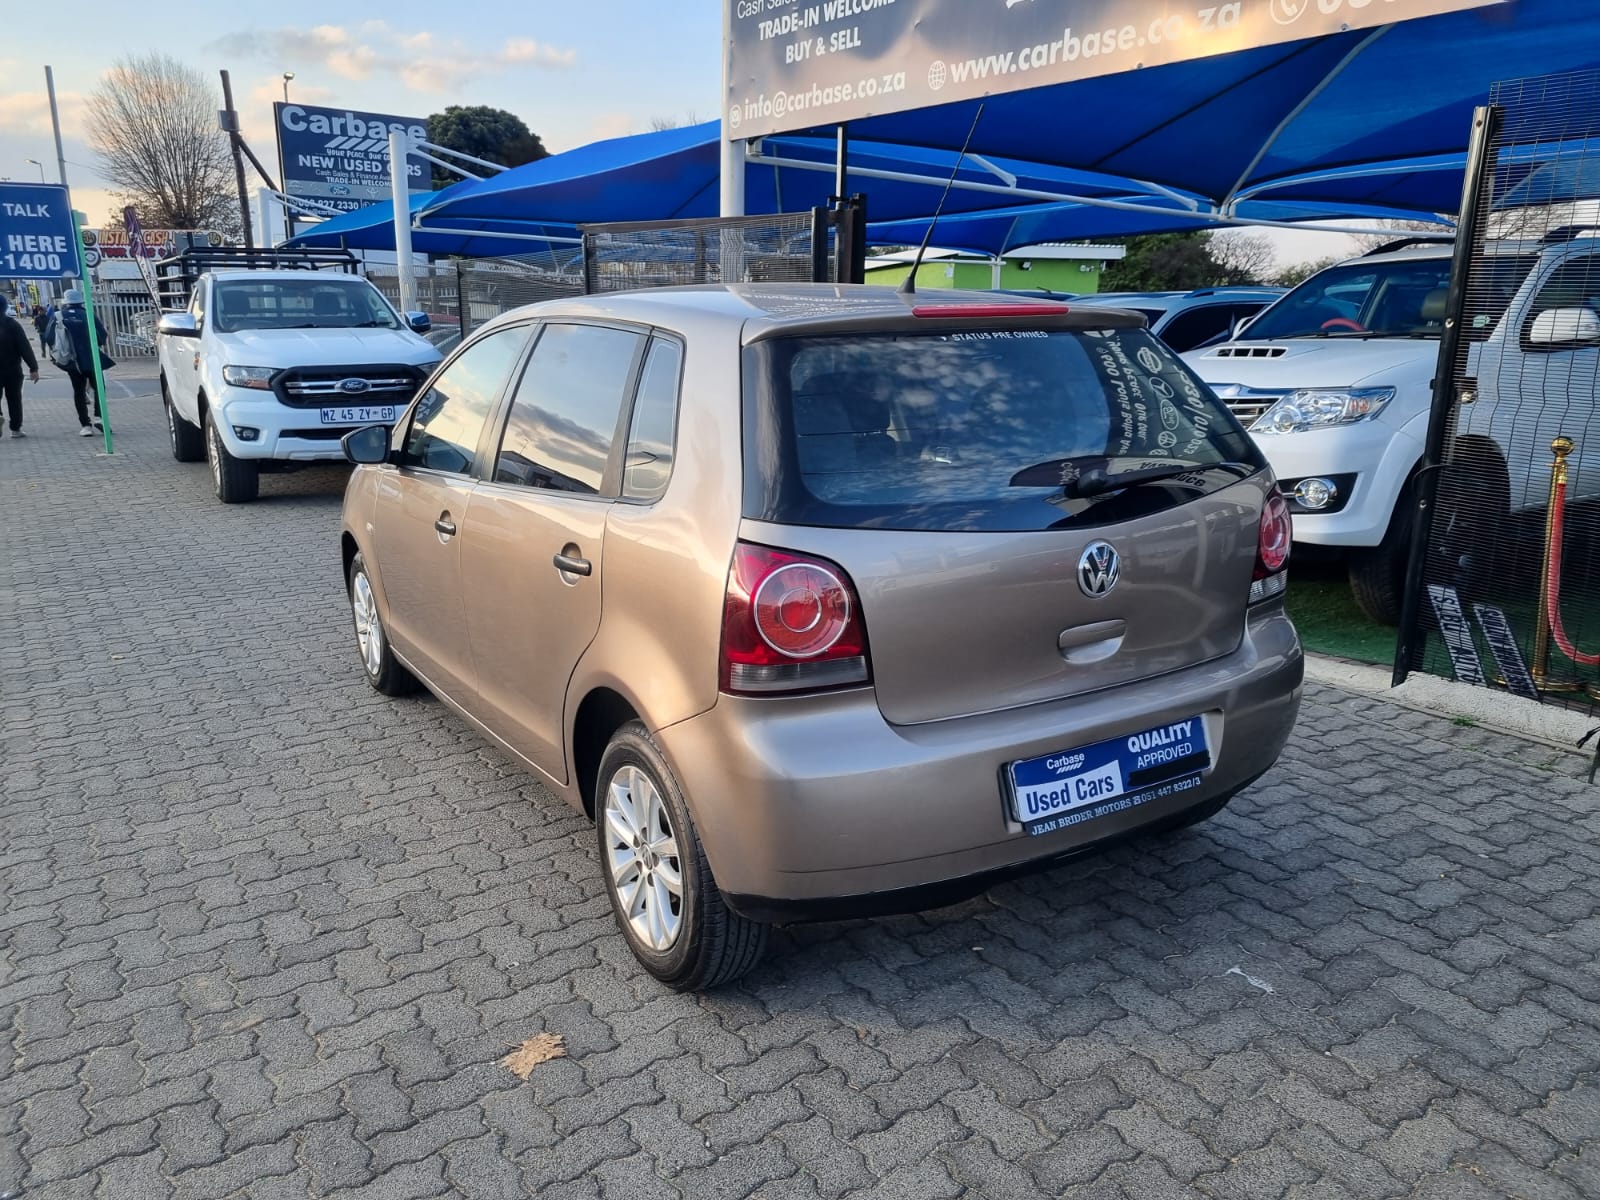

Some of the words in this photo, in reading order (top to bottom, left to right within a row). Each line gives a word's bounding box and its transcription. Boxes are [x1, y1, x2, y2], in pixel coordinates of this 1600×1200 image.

[737, 1, 763, 19] Cash
[759, 6, 820, 41] TRADE-IN
[785, 38, 813, 64] BUY
[815, 36, 826, 57] &
[830, 27, 861, 53] SELL
[949, 2, 1241, 83] www.carbase.co.za
[744, 71, 906, 120] info@carbase.co.za
[281, 105, 427, 144] Carbase
[298, 154, 335, 169] NEW
[344, 158, 383, 173] USED
[386, 162, 422, 177] CRS
[315, 169, 331, 177] Cash
[332, 170, 349, 178] Sales
[356, 172, 380, 180] Finance
[326, 176, 360, 185] TRADE-IN
[2, 203, 51, 218] TALK
[337, 200, 360, 210] 2330
[7, 234, 68, 253] HERE
[143, 231, 169, 248] CASH
[952, 332, 992, 341] STATUS
[992, 331, 1013, 339] PRE
[1013, 331, 1049, 339] OWNED
[345, 381, 363, 389] Ford
[322, 409, 336, 421] MZ
[341, 409, 353, 420] 45
[359, 408, 371, 420] ZY
[381, 407, 393, 419] GP
[1127, 721, 1192, 753] QUALITY
[1046, 752, 1085, 770] Carbase
[1137, 743, 1193, 769] APPROVED
[1026, 782, 1071, 815] Used
[1075, 775, 1115, 801] Cars
[1032, 819, 1057, 836] JEAN
[1059, 810, 1094, 828] BRIDER
[1095, 799, 1132, 817] MOTORS
[1141, 791, 1156, 802] 051
[1158, 786, 1171, 796] 447
